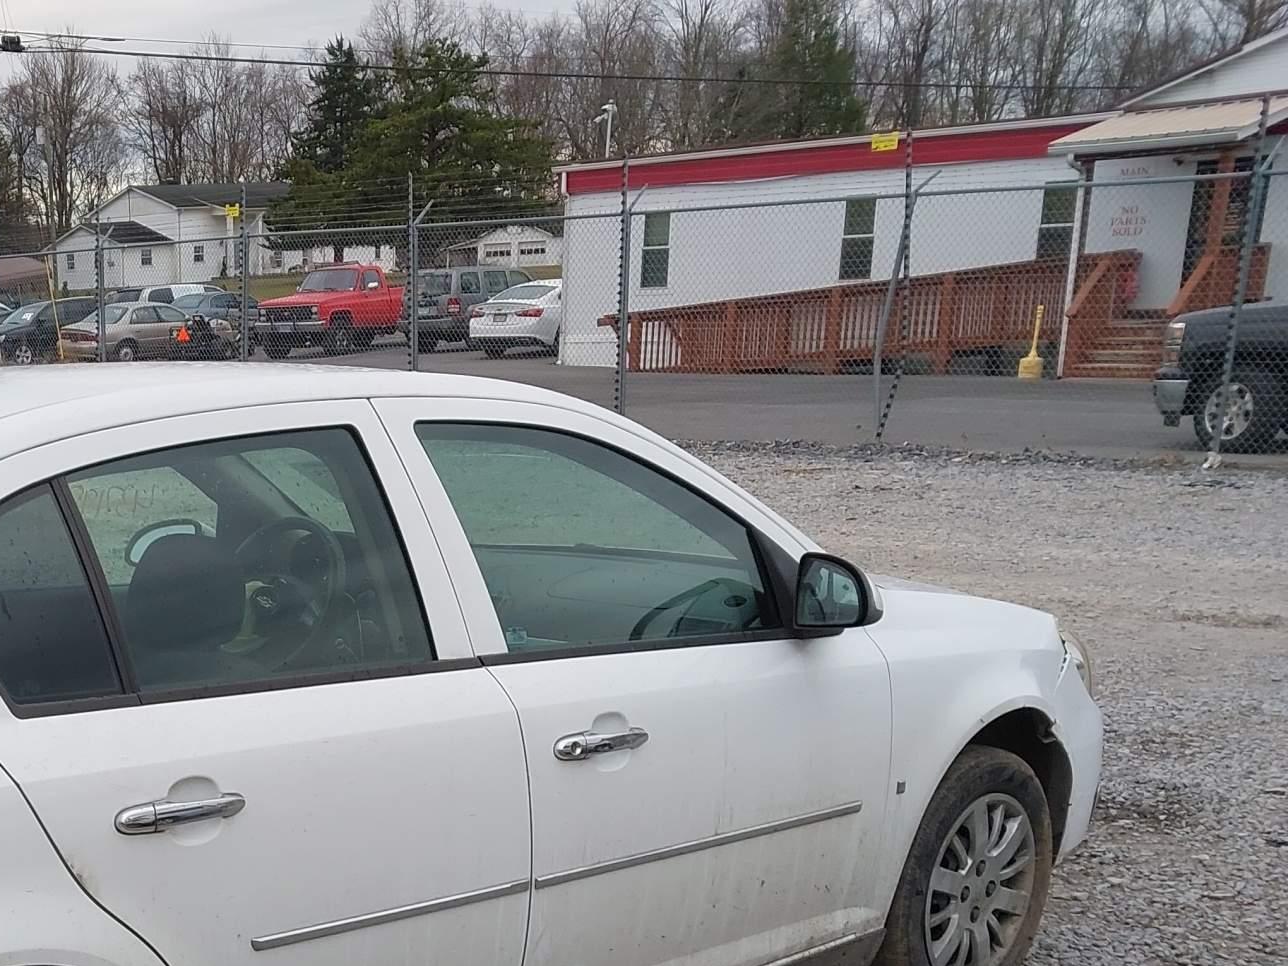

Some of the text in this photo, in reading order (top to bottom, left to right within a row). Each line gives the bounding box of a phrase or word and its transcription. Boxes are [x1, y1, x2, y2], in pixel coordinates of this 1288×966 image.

[1120, 167, 1150, 176] MAIN
[1121, 206, 1140, 214] NO
[1111, 216, 1147, 226] PARTS
[1112, 227, 1144, 237] SOLD
